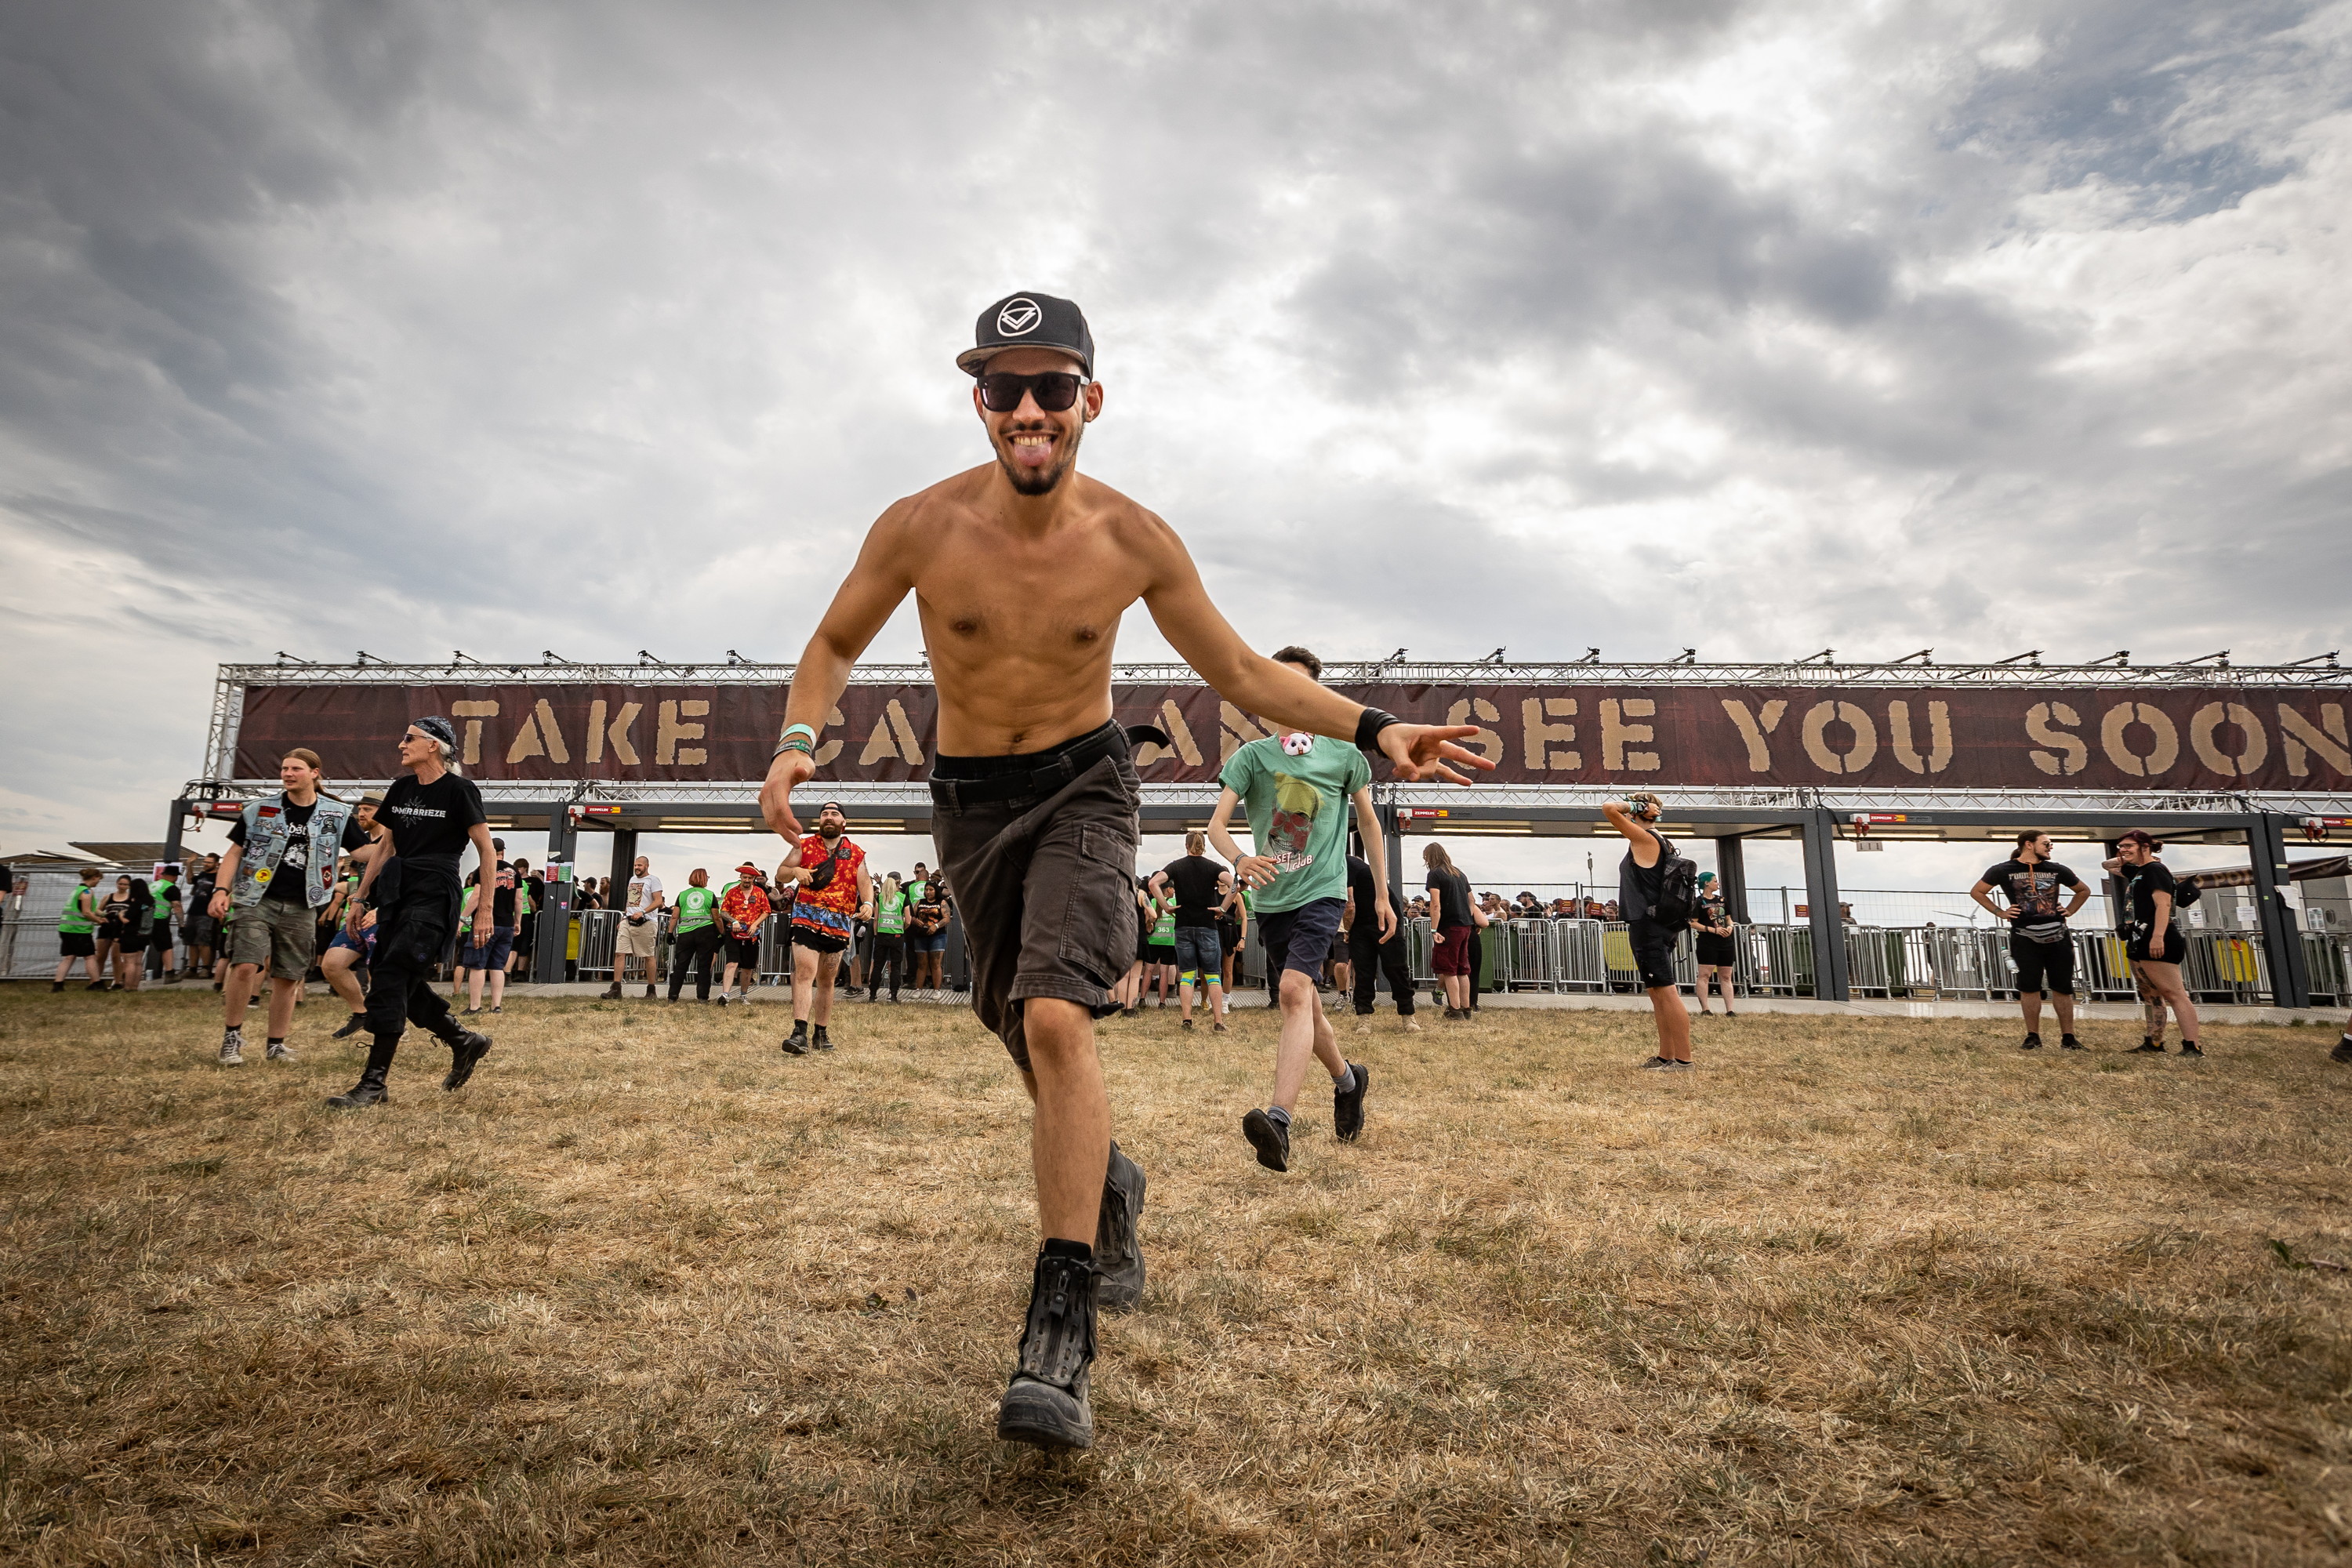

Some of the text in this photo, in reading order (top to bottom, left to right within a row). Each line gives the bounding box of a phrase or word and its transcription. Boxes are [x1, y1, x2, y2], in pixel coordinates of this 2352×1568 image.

[451, 699, 710, 766] TAKE
[1445, 697, 1661, 771] SEE
[1720, 699, 1954, 775] YOU
[2024, 701, 2352, 777] SOON
